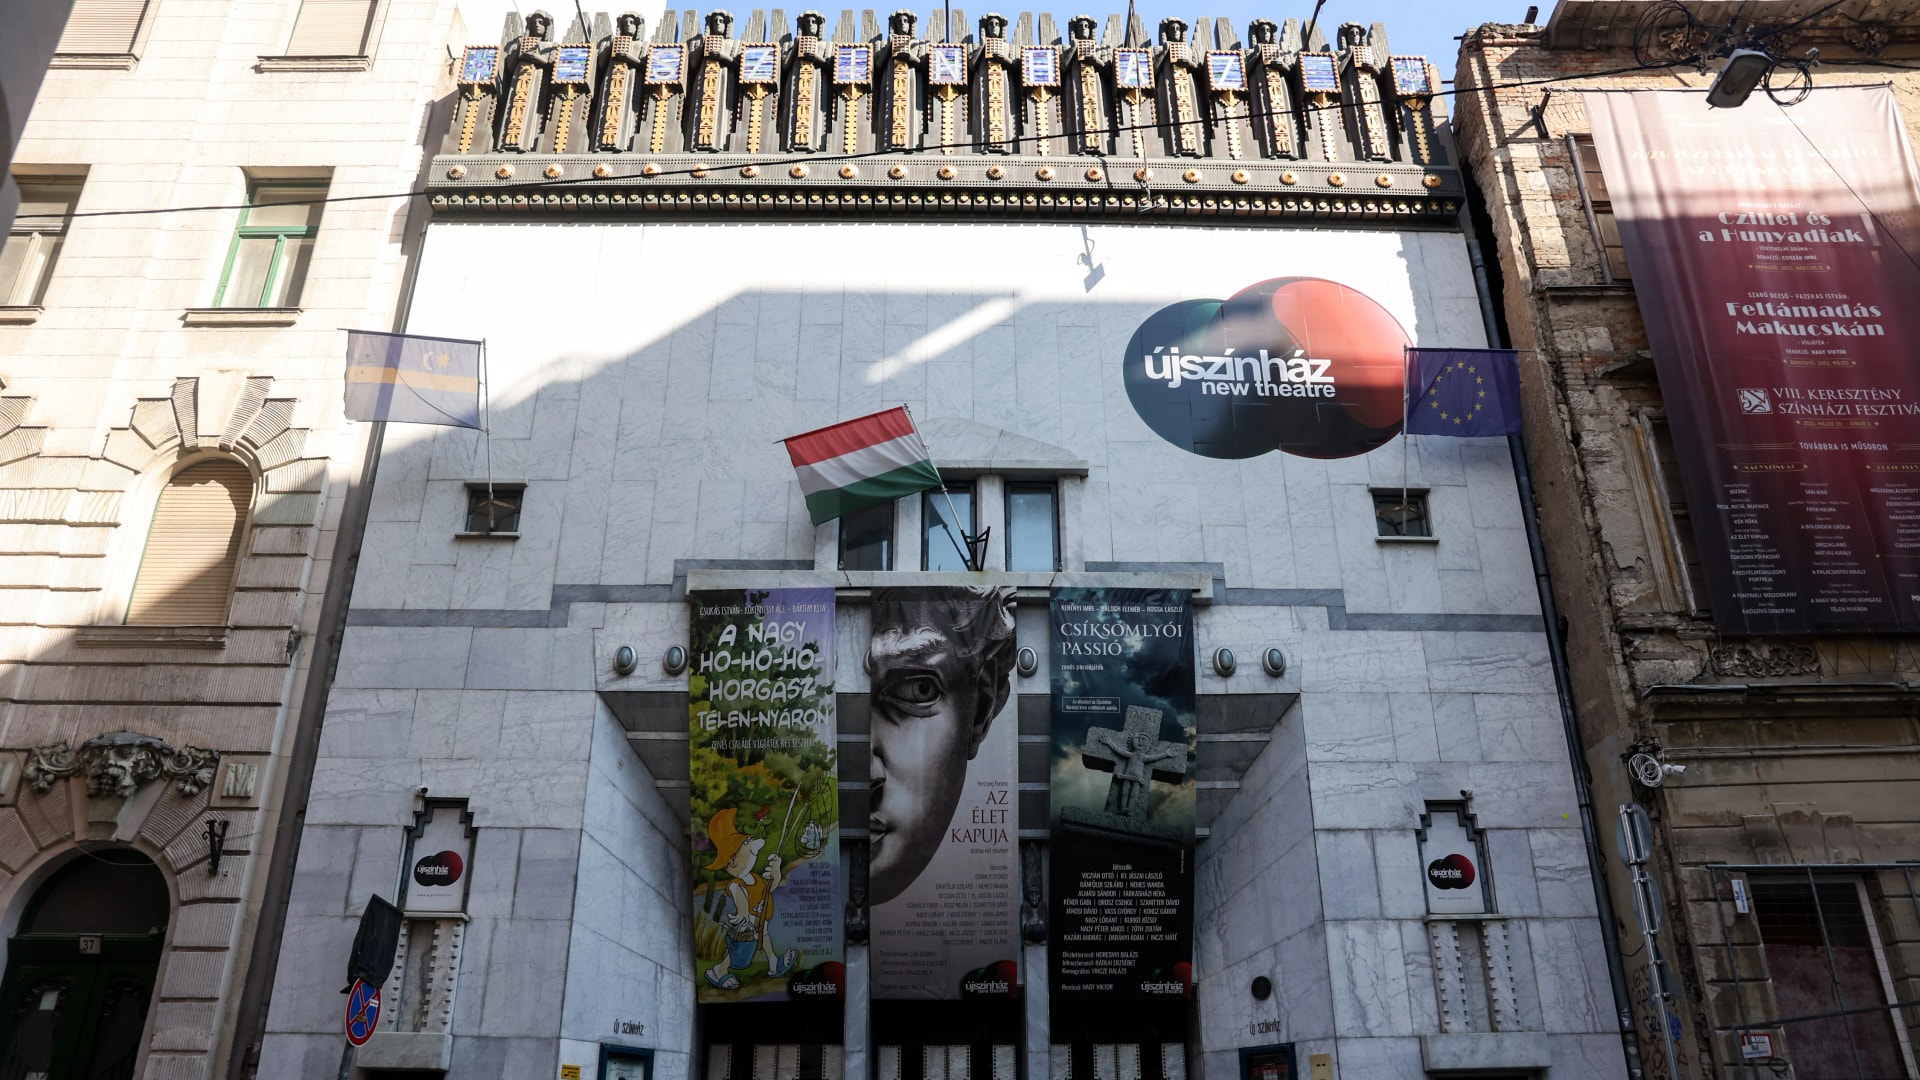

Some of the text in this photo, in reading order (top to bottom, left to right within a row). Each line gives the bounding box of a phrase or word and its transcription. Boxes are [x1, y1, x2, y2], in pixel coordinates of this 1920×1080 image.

[1718, 211, 1832, 226] Czillei és
[1699, 228, 1865, 244] a Hunyadiak
[1725, 302, 1882, 318] Feltámadás
[1736, 320, 1885, 337] Makucskán
[1144, 345, 1335, 388] újszínház
[1201, 378, 1336, 398] new theatre
[1772, 386, 1901, 401] VIII. KERESZTÉNY
[1778, 401, 1852, 416] SZÍNHÁZI
[1799, 441, 1889, 451] TOVÁBBRA IS MŰSORON
[1082, 604, 1095, 612] IMRE
[1146, 605, 1164, 613] ROSSA
[1164, 605, 1183, 613] LÁSZLÓ
[718, 621, 807, 647] A NAGY
[1060, 619, 1183, 640] CSÍKSOMLYÓI
[1061, 639, 1122, 656] PASSIÓ
[709, 676, 817, 703] HORGÁSZ
[697, 708, 829, 731] TÉLEN-NYÁRON
[986, 790, 1008, 805] AZ
[972, 806, 1008, 824] ÉLET
[951, 828, 1008, 846] KAPUJA
[82, 939, 95, 951] 37
